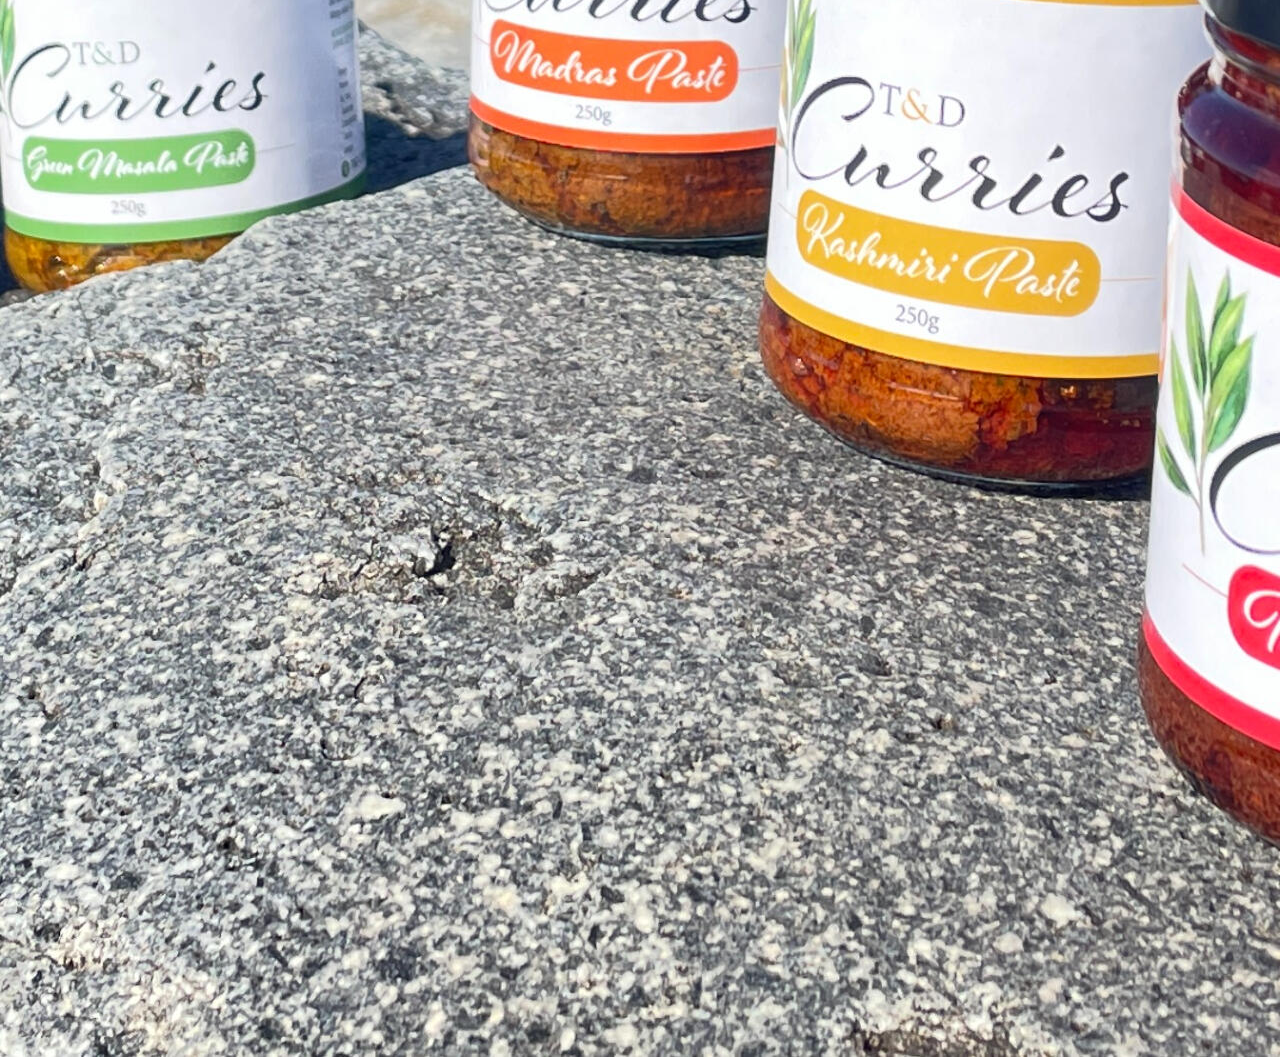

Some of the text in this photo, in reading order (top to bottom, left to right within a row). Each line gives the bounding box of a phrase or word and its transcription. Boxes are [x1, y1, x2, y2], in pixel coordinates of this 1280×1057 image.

[72, 40, 141, 66] T&D
[493, 29, 727, 94] Madras Paste
[7, 43, 269, 129] Curries
[879, 82, 967, 129] T&D
[574, 104, 613, 127] 250g
[26, 141, 250, 182] Green Masala Paste
[792, 76, 1129, 223] Curries
[110, 199, 148, 217] 250g
[802, 201, 1083, 303] Kashmiri Paste
[894, 304, 941, 334] 250g
